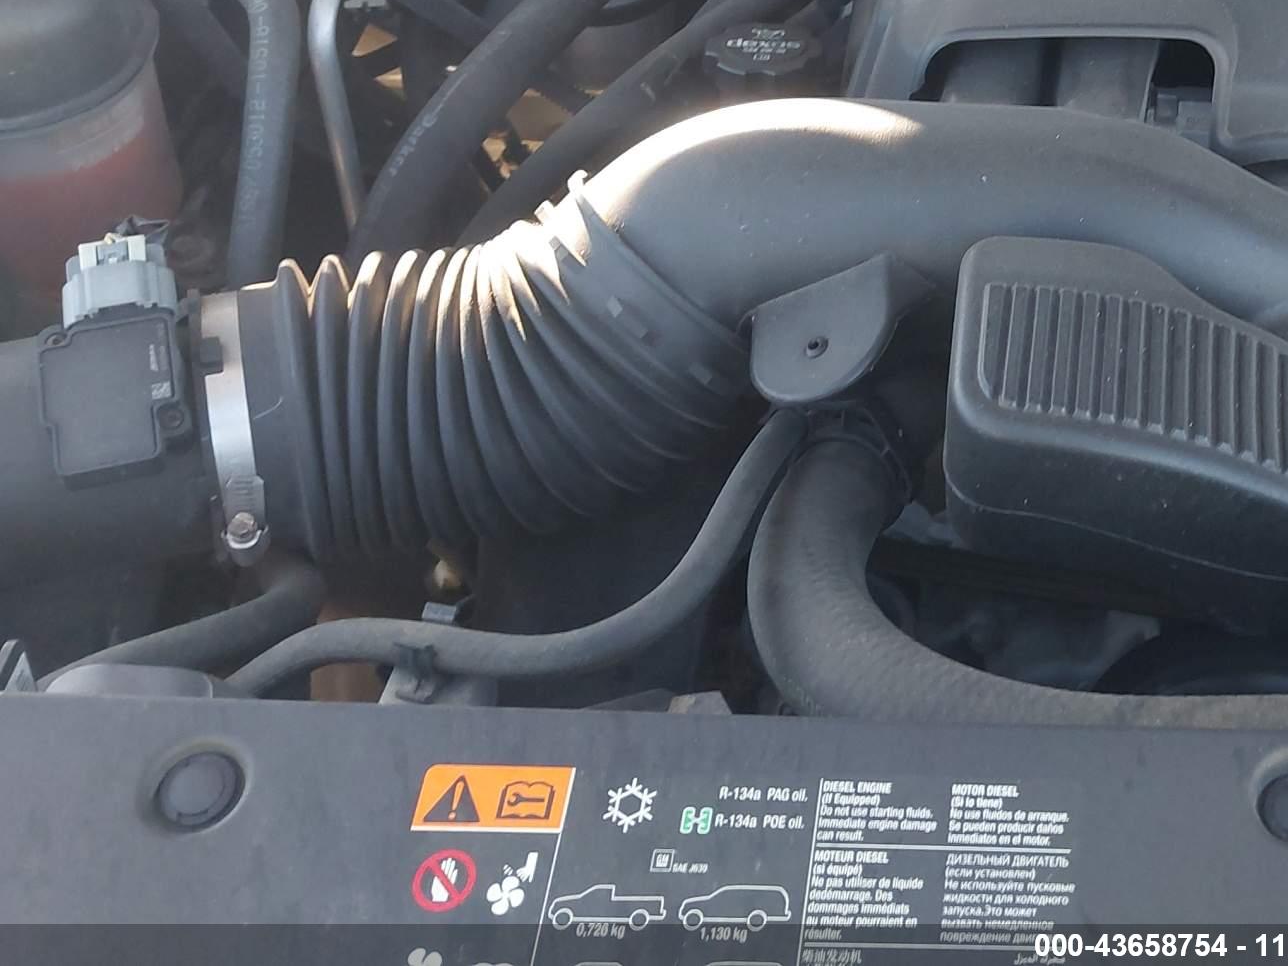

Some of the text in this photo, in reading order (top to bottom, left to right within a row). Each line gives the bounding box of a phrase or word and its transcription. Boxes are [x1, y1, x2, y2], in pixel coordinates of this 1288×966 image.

[719, 786, 762, 802] R-134a
[767, 788, 792, 802] PAG
[823, 780, 892, 794] DIESEL ENGINE
[952, 784, 1019, 798] MOTOR DIESEL
[833, 794, 880, 807] Equipped)
[976, 797, 1003, 809] tiene)
[820, 805, 934, 820] Do not use starting fluids.
[949, 808, 1070, 824] No use fluidos de arranque.
[715, 814, 758, 829] R-134a
[763, 815, 787, 830] POE
[818, 817, 938, 833] Immediate engine damage
[948, 820, 1064, 835] Se pueden producir daños
[816, 831, 864, 842] can result.
[998, 835, 1011, 845] en
[1012, 834, 1021, 846] el
[1022, 836, 1052, 847] motor.
[814, 850, 889, 863] MOTEUR DIESEL
[946, 853, 1070, 868] ДИЗЕЛЬНЫЙ ДВИГАТЕЛЬ
[672, 861, 687, 873] SAE
[812, 863, 863, 877] (si équipé)
[945, 866, 1036, 881] (если установлен)
[811, 875, 924, 891] Ne pas utiliser de liquide
[944, 879, 1076, 895] Не используйте пусковые
[874, 889, 894, 902] Des
[943, 893, 1070, 907] жидкости для холодного
[807, 901, 910, 915] dommages immédiats
[1004, 907, 1038, 918] может
[805, 915, 919, 930] au moteur pourraient en
[610, 923, 627, 940] kg
[700, 927, 748, 945] 1,130 kg
